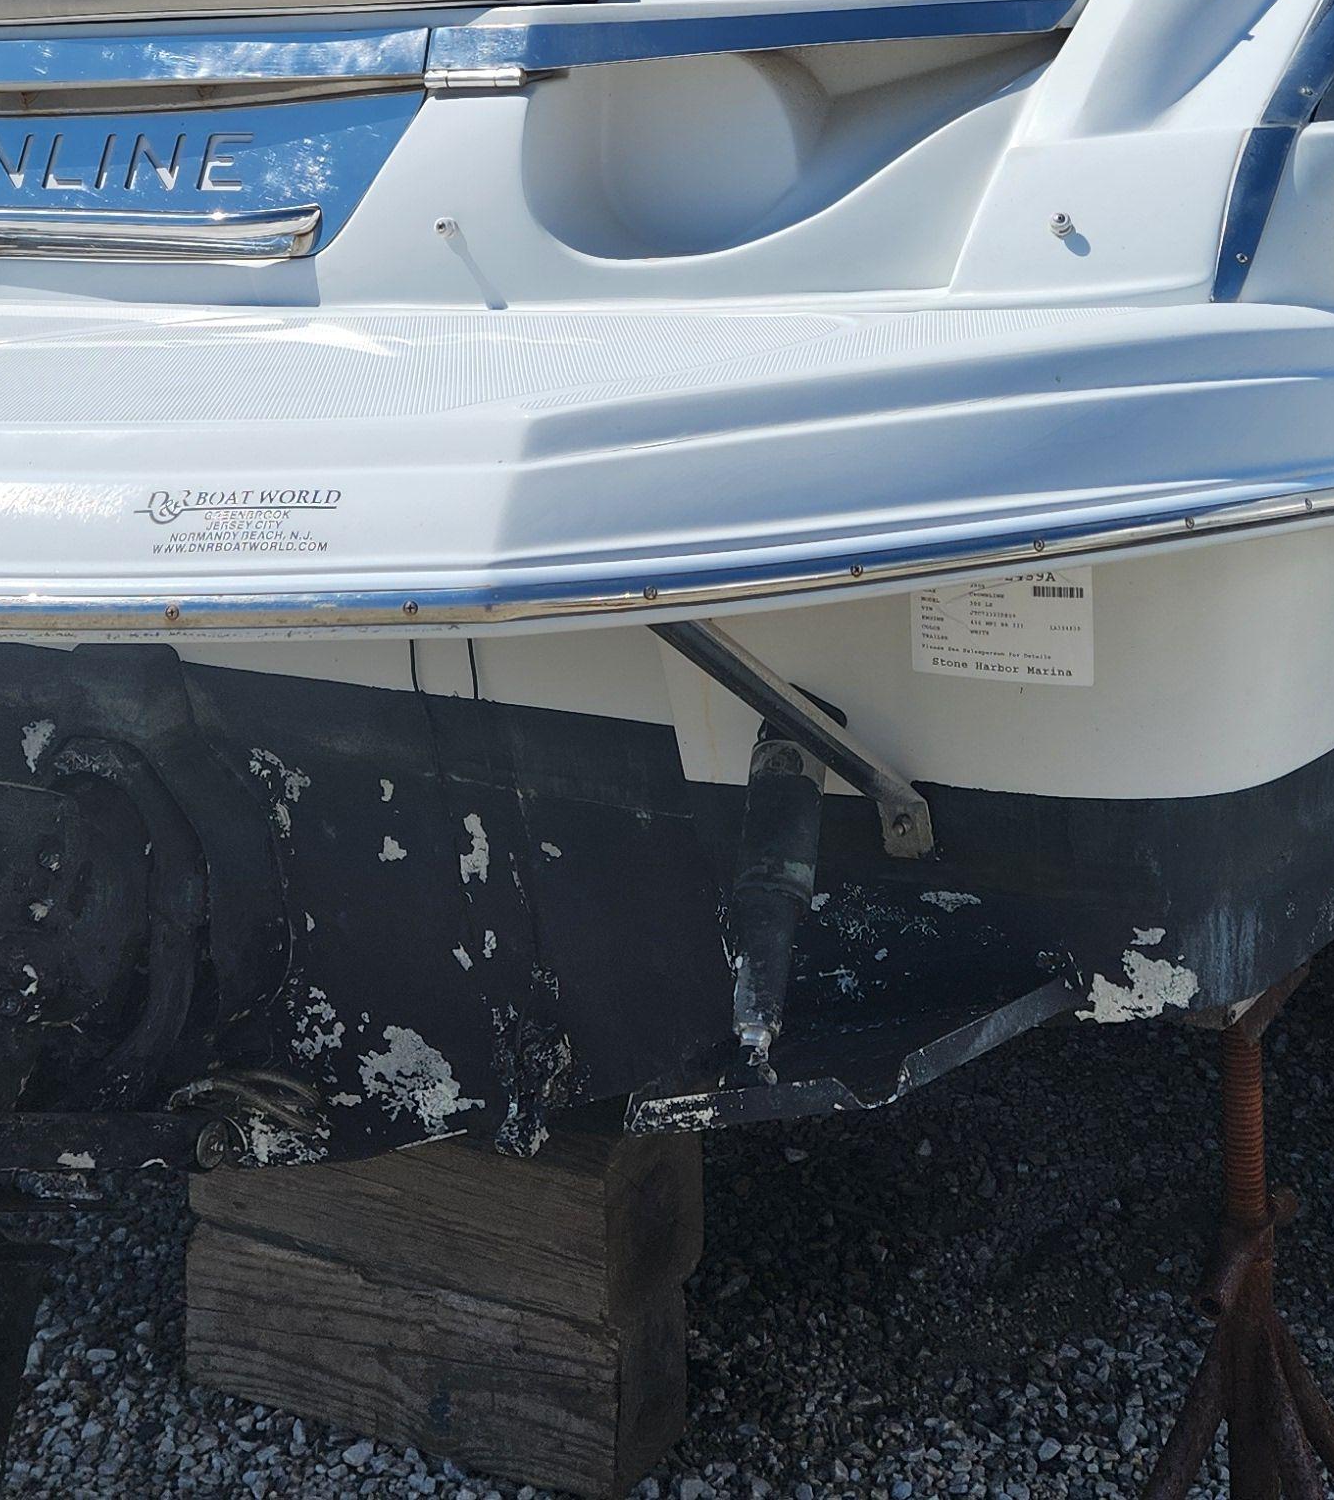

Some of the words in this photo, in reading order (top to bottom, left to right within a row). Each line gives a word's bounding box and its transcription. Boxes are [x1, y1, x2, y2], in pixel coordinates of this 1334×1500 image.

[196, 490, 254, 506] BOAT
[260, 489, 342, 504] WORLD
[205, 521, 253, 531] JERSEY
[254, 520, 284, 530] CITY
[169, 532, 240, 542] NORMANDY
[241, 531, 286, 541] BEACH,
[289, 531, 313, 540] N.J.
[152, 541, 328, 554] WWW.DNRBOATWORLD.COM
[932, 657, 968, 669] Stone
[975, 662, 1019, 674] Harbor
[1027, 666, 1072, 677] Marina
